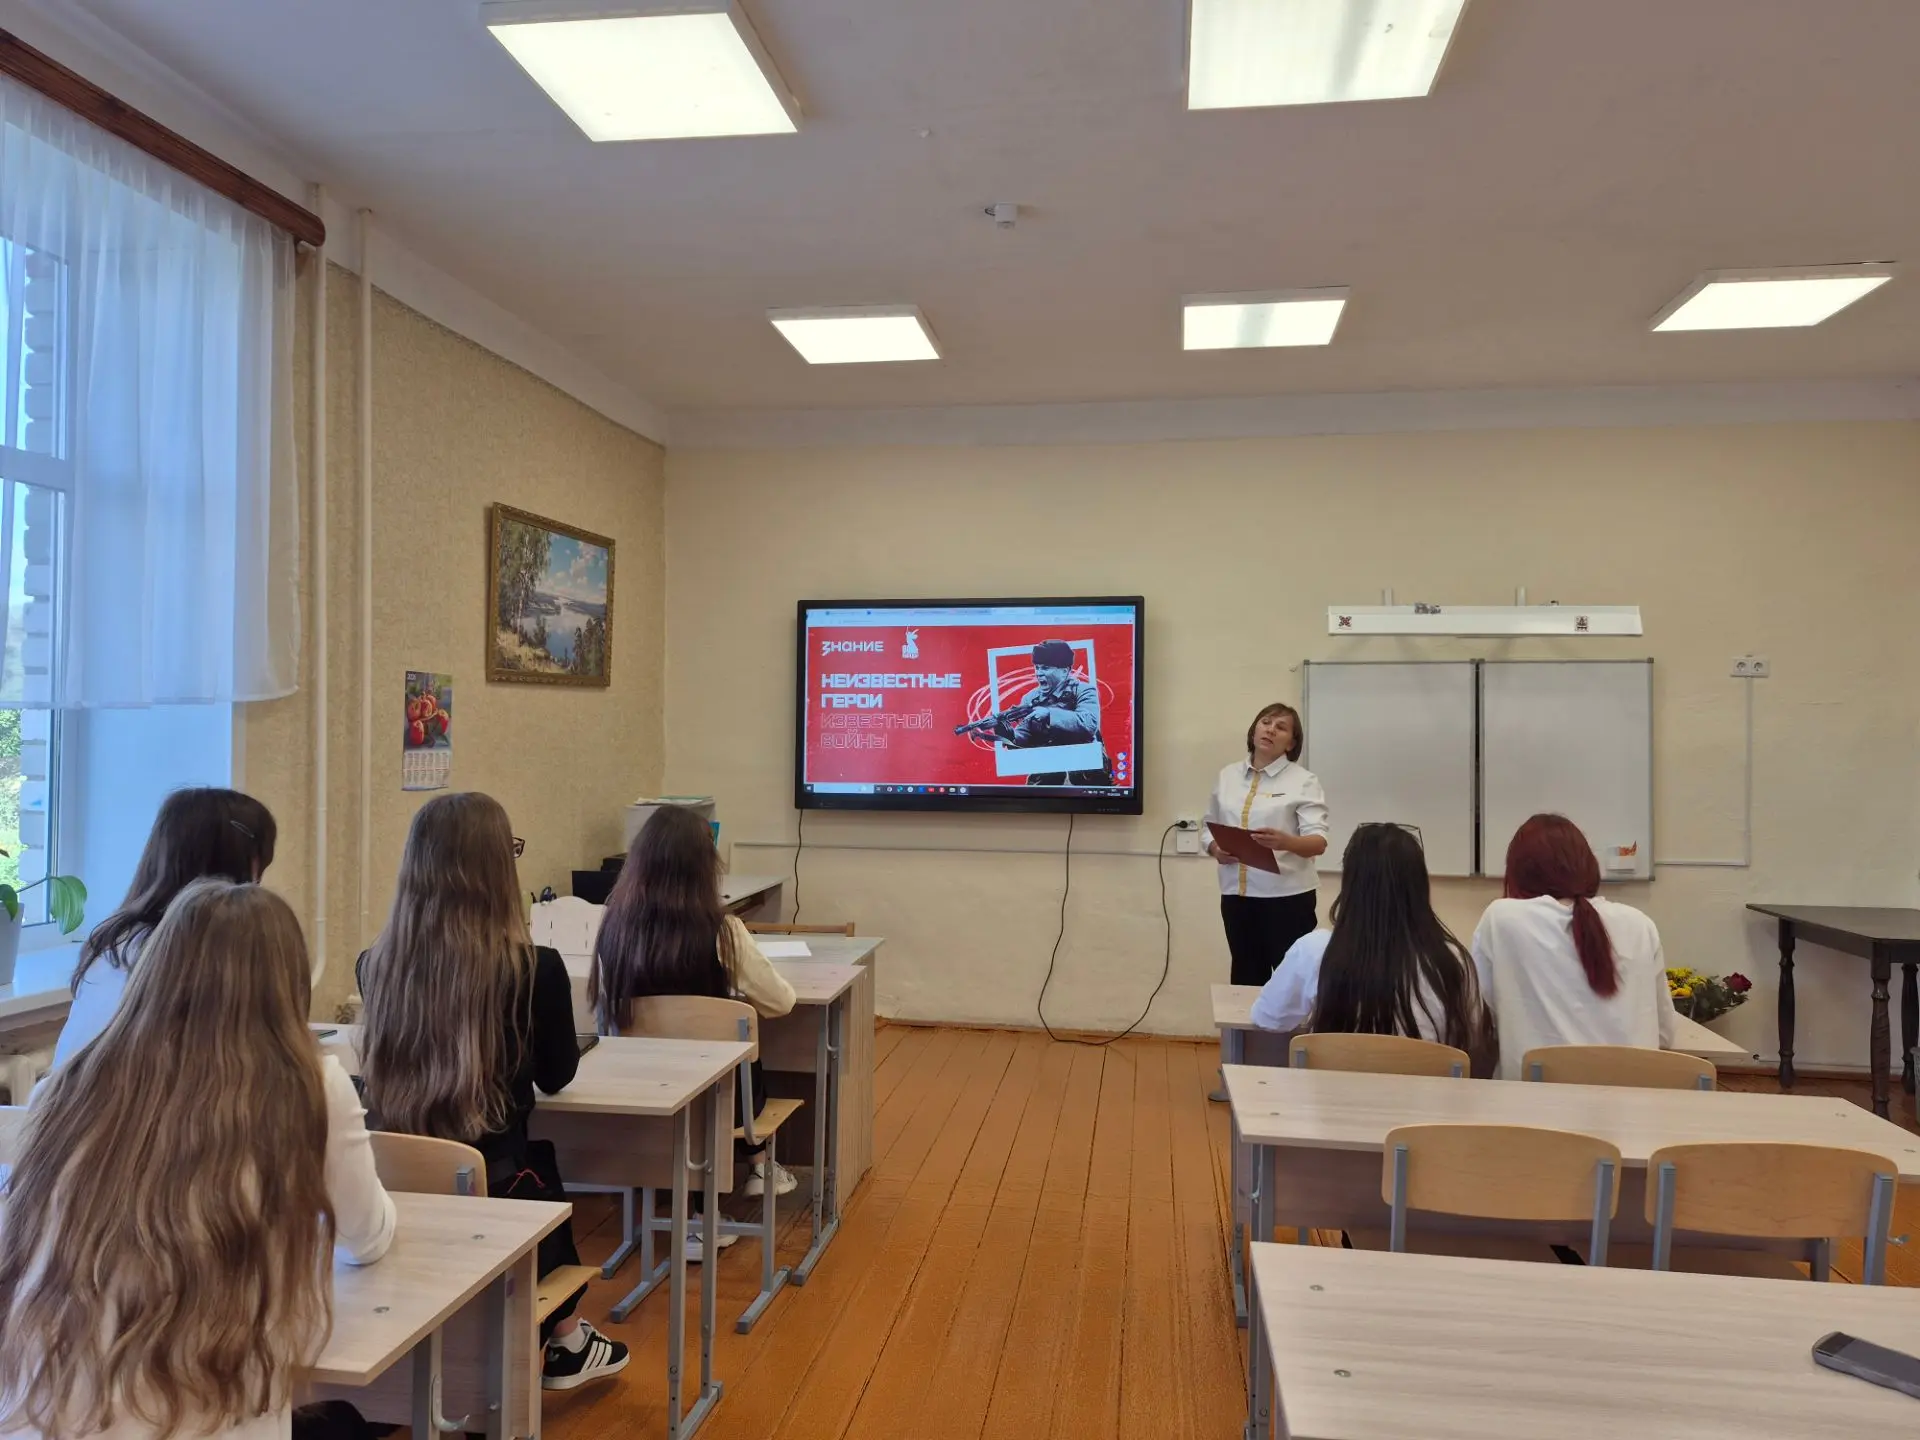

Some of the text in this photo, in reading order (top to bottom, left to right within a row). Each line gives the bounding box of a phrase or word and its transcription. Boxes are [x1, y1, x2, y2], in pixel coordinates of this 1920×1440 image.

[821, 673, 961, 689] НЕИЗВЕСТНЫЕ
[821, 693, 883, 708] ГЕРОИ
[821, 709, 932, 729] ИЗВЕСТНОЙ
[821, 729, 887, 748] ВОЙНЫ
